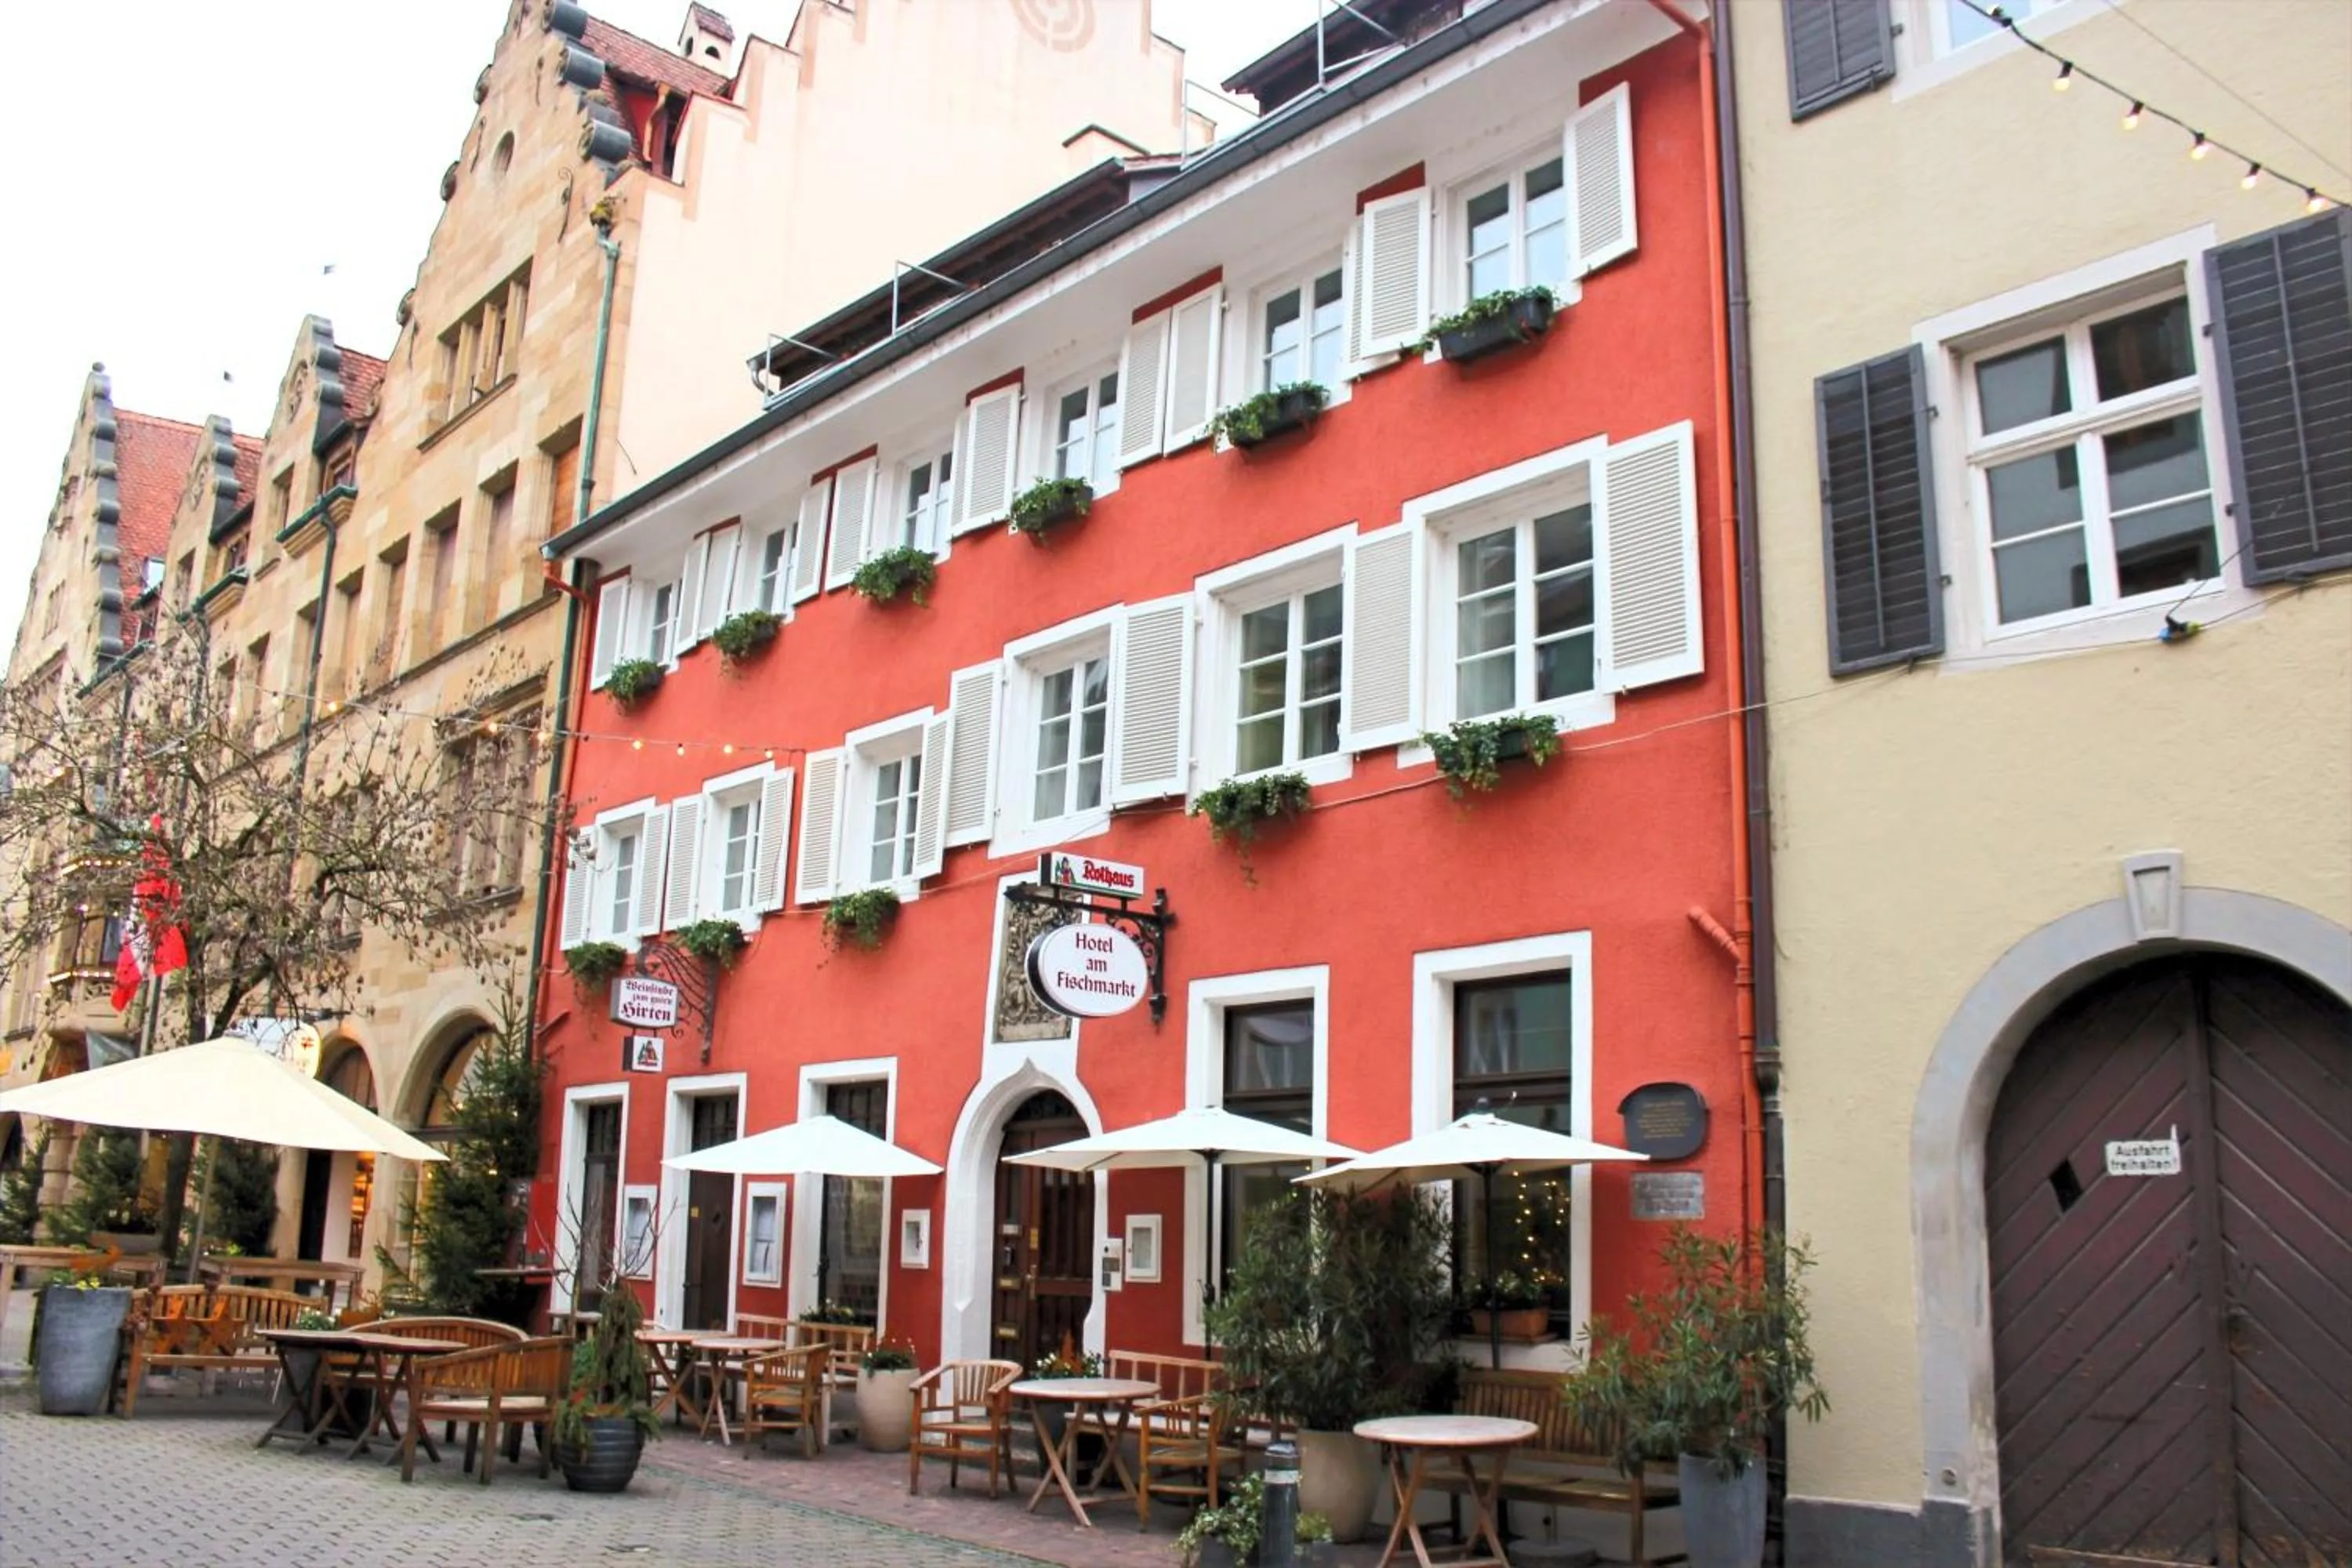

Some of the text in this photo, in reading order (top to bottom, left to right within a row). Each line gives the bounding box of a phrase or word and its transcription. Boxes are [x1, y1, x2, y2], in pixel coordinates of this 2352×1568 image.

[1083, 859, 1134, 889] Rothaus
[1076, 931, 1113, 953] Hotel
[1086, 956, 1108, 973] am
[1057, 971, 1136, 998] Fischmarkt
[621, 1001, 670, 1021] Hirten
[2116, 1145, 2170, 1156] Ausfahrt
